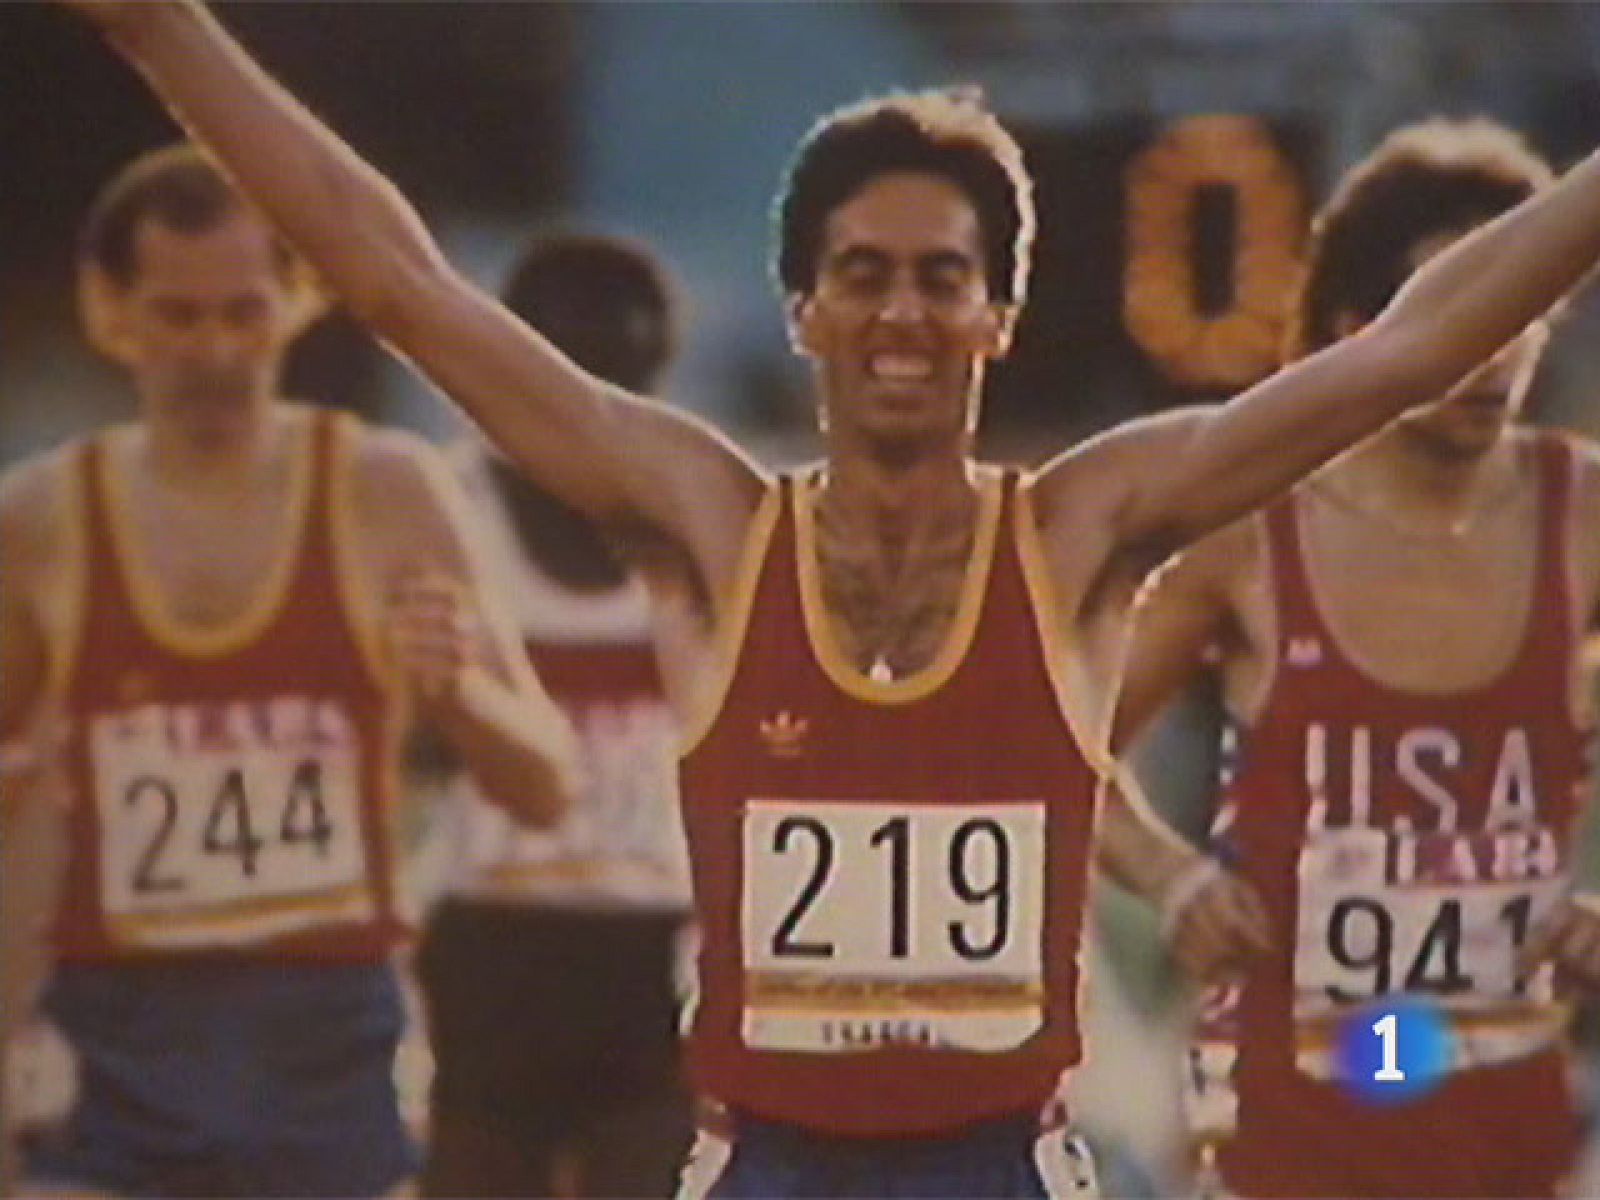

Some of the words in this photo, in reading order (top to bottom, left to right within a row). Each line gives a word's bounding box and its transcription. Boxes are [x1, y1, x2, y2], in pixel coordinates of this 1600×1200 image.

[124, 762, 333, 894] 244
[1305, 724, 1536, 834] USA
[772, 816, 1010, 960] 219
[1324, 895, 1531, 1003] 941
